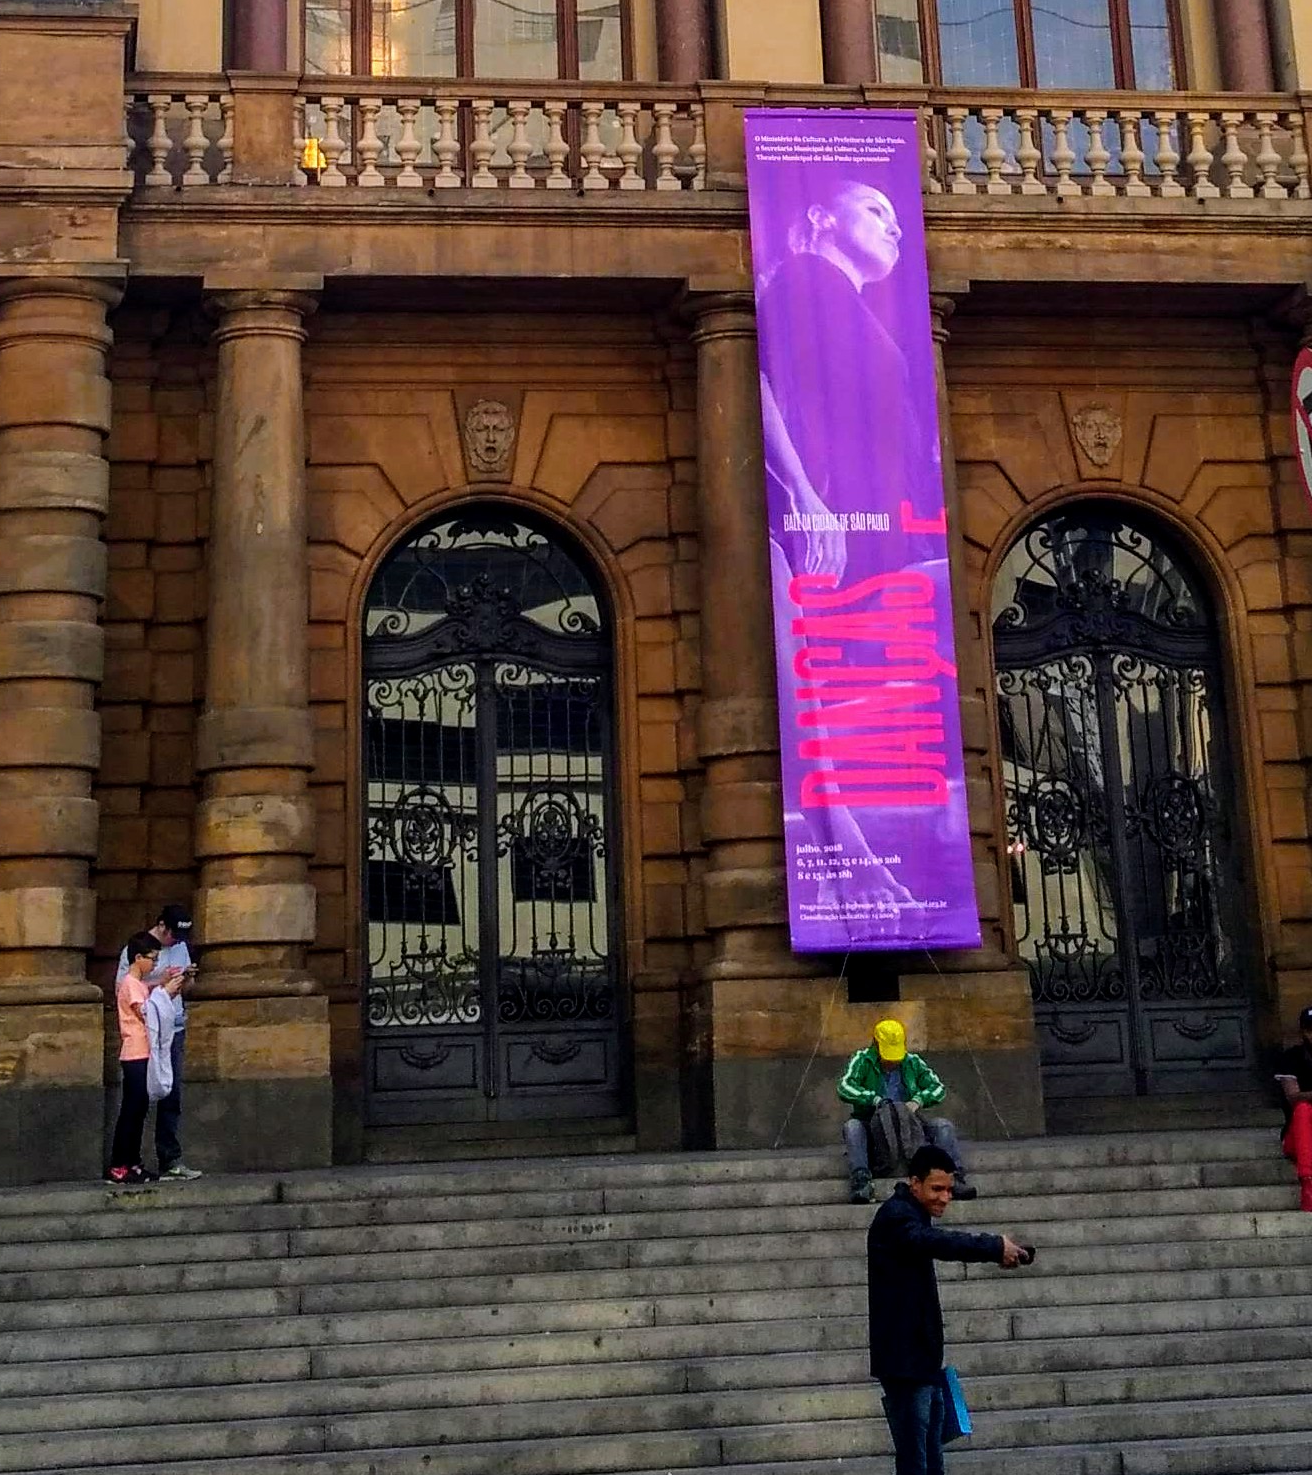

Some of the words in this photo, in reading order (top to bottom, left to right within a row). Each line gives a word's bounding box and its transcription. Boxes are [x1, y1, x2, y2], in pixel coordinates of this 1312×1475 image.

[850, 510, 866, 531] SÃO
[867, 512, 890, 531] PAULO
[788, 571, 957, 808] DANÇAS
[823, 843, 843, 853] 2018
[884, 854, 902, 864] 20h
